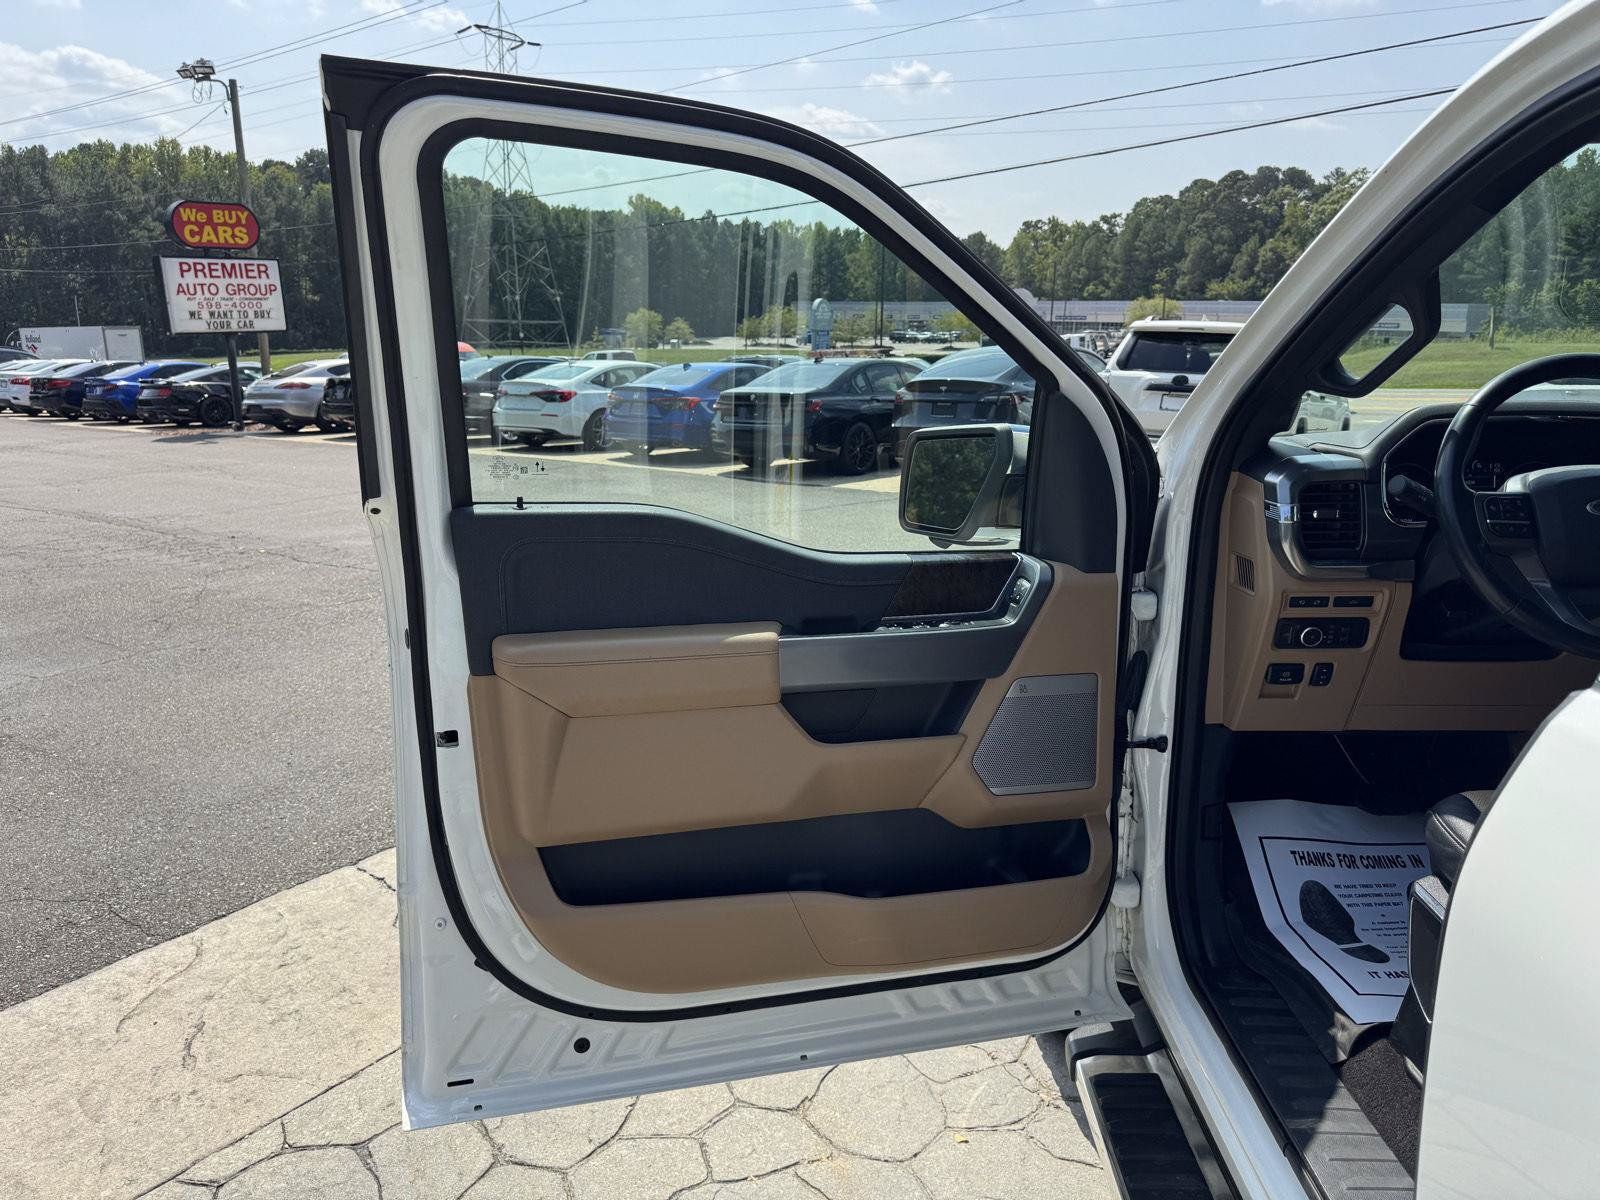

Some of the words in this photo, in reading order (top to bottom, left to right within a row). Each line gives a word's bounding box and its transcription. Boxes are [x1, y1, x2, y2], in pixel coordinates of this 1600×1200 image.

[180, 207, 207, 223] We
[212, 209, 249, 225] BUY
[183, 224, 249, 244] CARS
[178, 261, 270, 279] PREMIER
[176, 283, 219, 296] AUTO
[225, 283, 277, 296] GROUP
[188, 310, 202, 320] WE
[208, 310, 233, 319] WANT
[237, 310, 248, 319] TO
[254, 310, 271, 319] BUY
[206, 320, 232, 330] YOUR
[237, 320, 255, 329] CAR
[1290, 850, 1335, 869] THANKS
[1336, 853, 1360, 870] FOR
[1359, 854, 1407, 870] COMING
[1407, 854, 1425, 869] IN
[1367, 971, 1381, 979] IT
[1383, 970, 1410, 979] HAS
